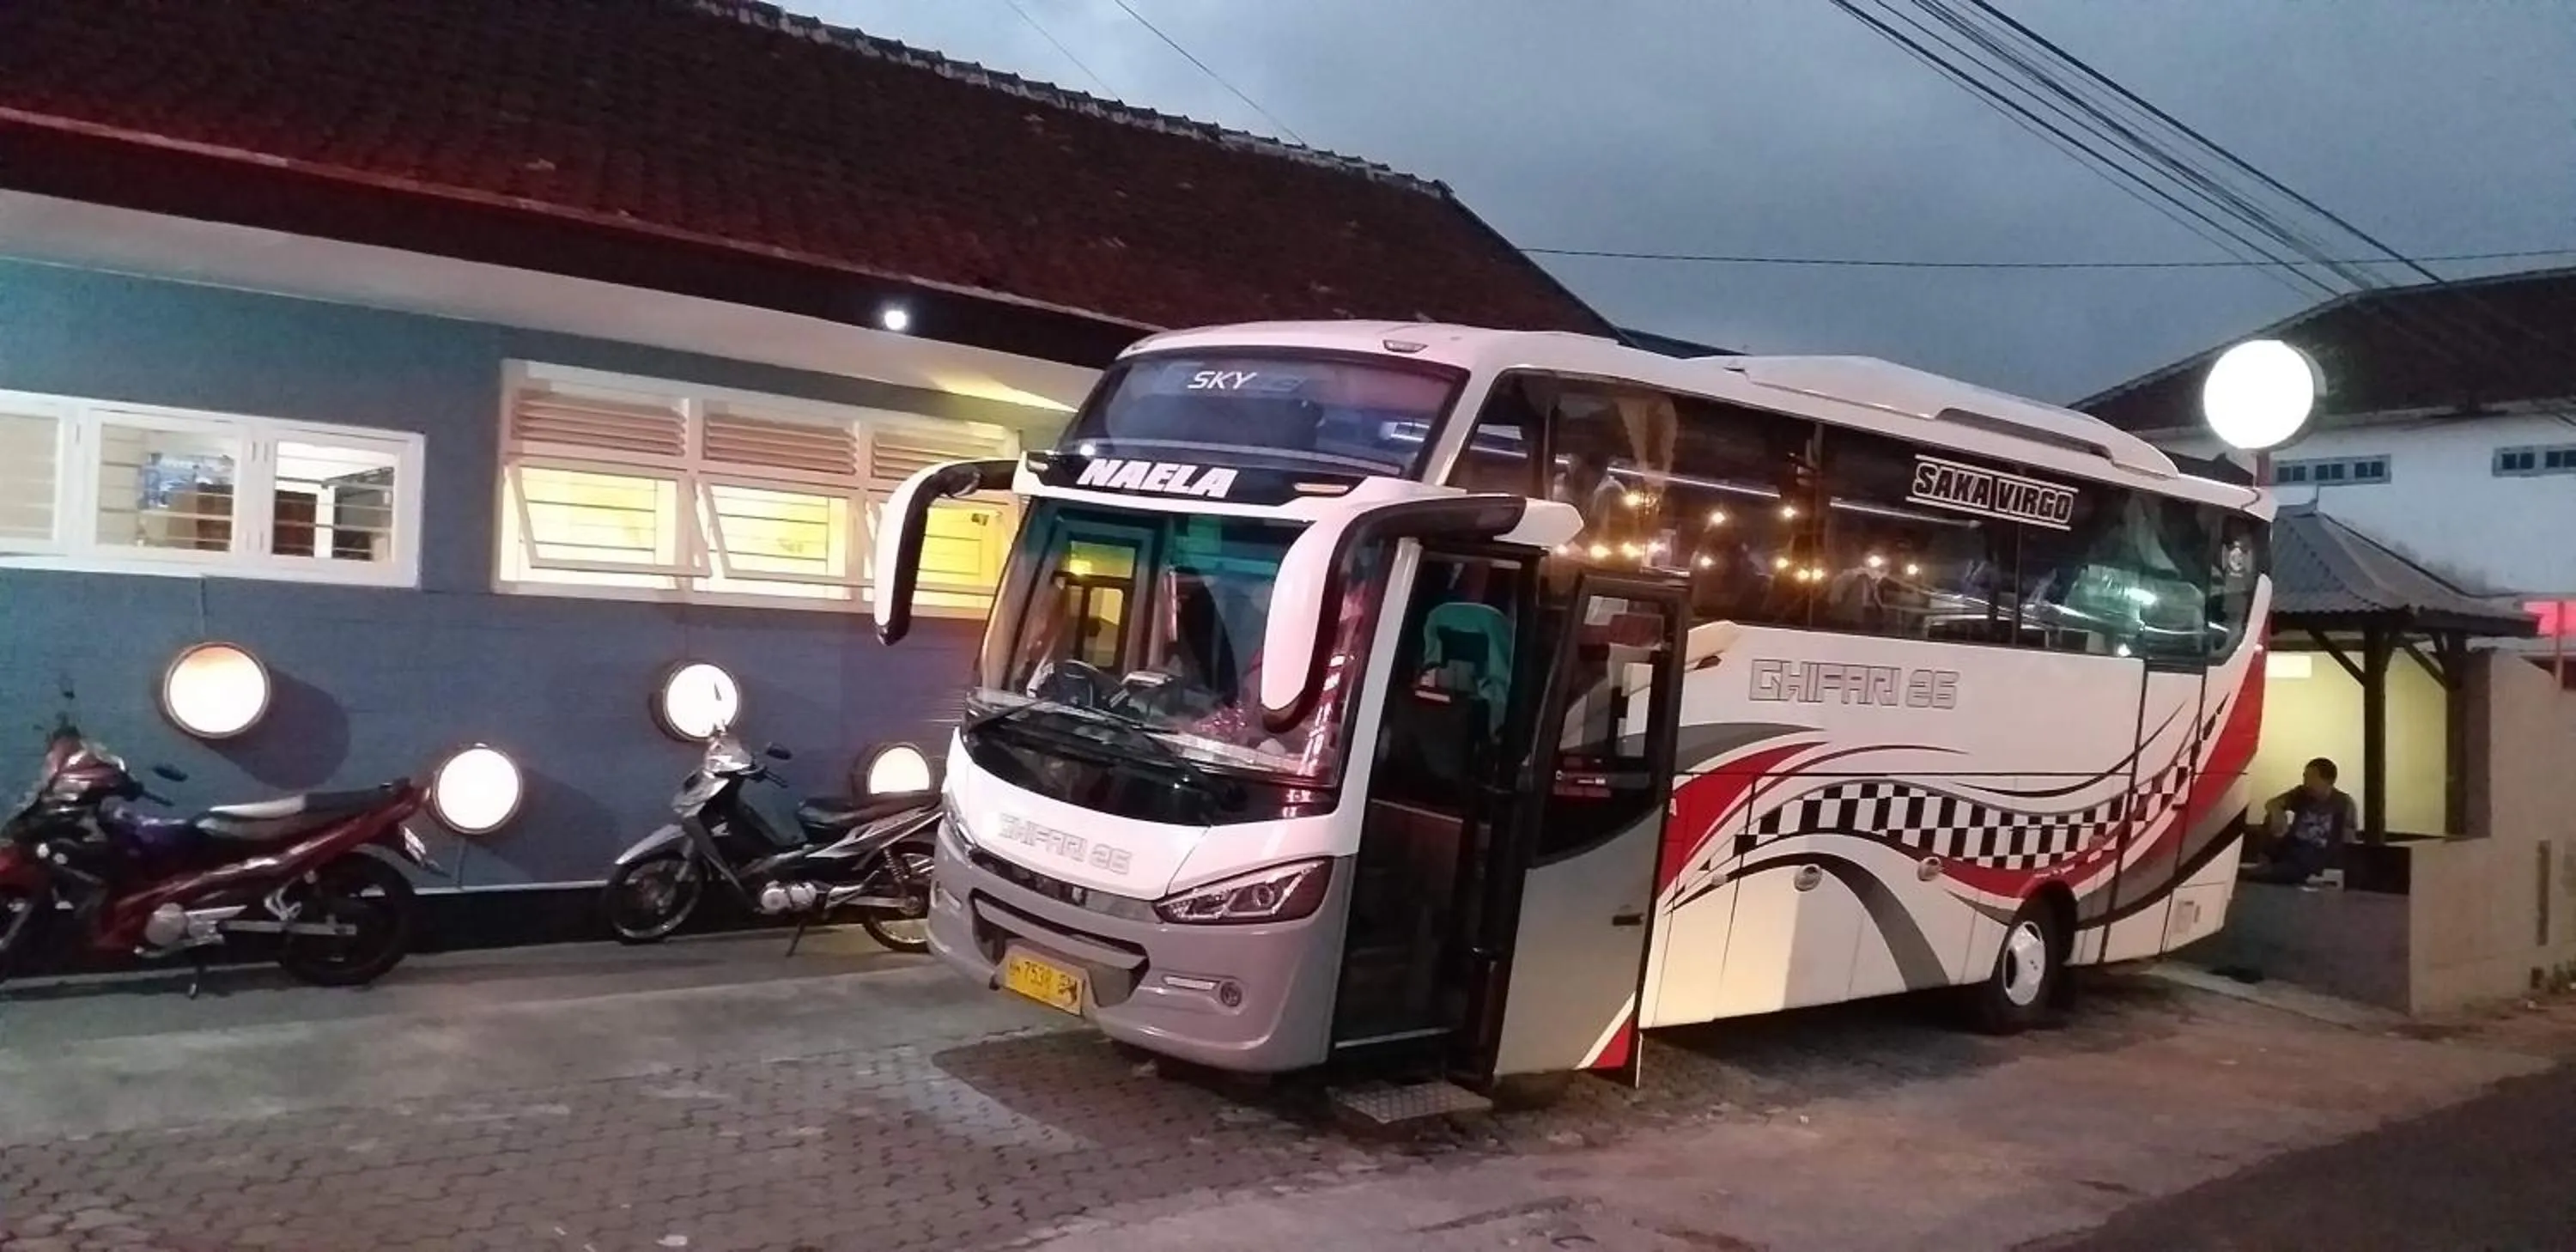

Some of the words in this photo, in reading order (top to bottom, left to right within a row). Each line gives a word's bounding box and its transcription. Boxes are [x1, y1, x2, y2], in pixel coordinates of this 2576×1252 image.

[1187, 370, 1258, 390] SKY
[1076, 458, 1238, 499] NAELA
[1912, 461, 1992, 509] SAKA
[1995, 477, 2074, 524] VIRGO
[1748, 659, 1902, 707] GHIFARI
